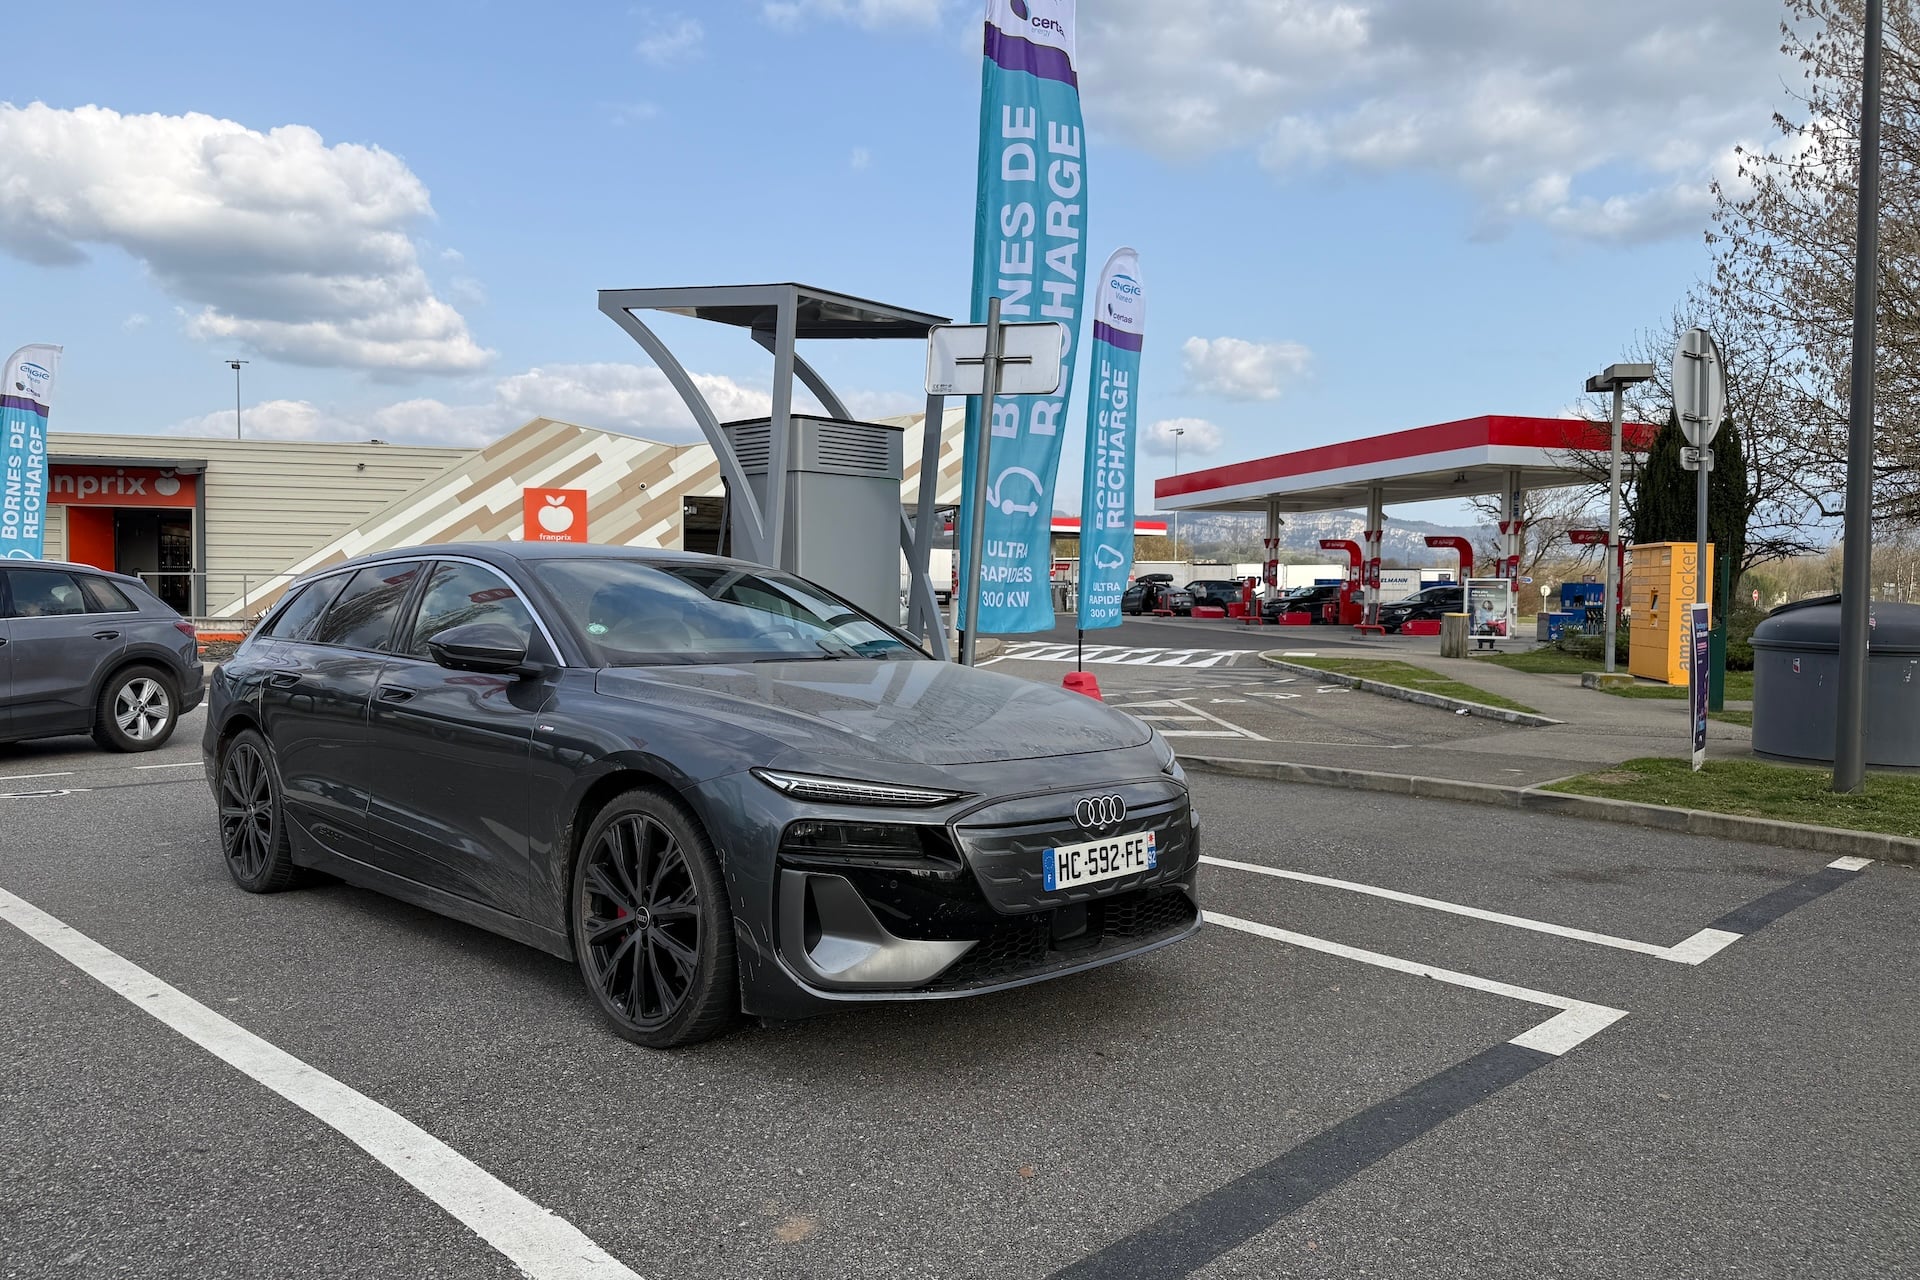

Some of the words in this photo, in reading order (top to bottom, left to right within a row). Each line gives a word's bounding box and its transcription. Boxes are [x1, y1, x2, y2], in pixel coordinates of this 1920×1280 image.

[1031, 17, 1065, 39] certa
[1002, 105, 1036, 182] DE
[992, 202, 1036, 439] BNES
[10, 420, 26, 449] DE
[1107, 369, 1128, 528] RECHARGE
[23, 426, 44, 539] RECHARGE
[48, 469, 147, 499] nprix
[1, 455, 22, 539] BORNES
[539, 533, 572, 542] franprix
[987, 540, 1028, 559] ULTRA
[981, 565, 1032, 583] RAPIDES
[982, 591, 1005, 608] 300
[1007, 591, 1029, 608] KW
[1092, 582, 1121, 592] ULTRA
[1089, 595, 1123, 605] RAPIDE
[1090, 608, 1106, 618] 300
[1047, 873, 1052, 883] F
[1148, 850, 1156, 865] 92
